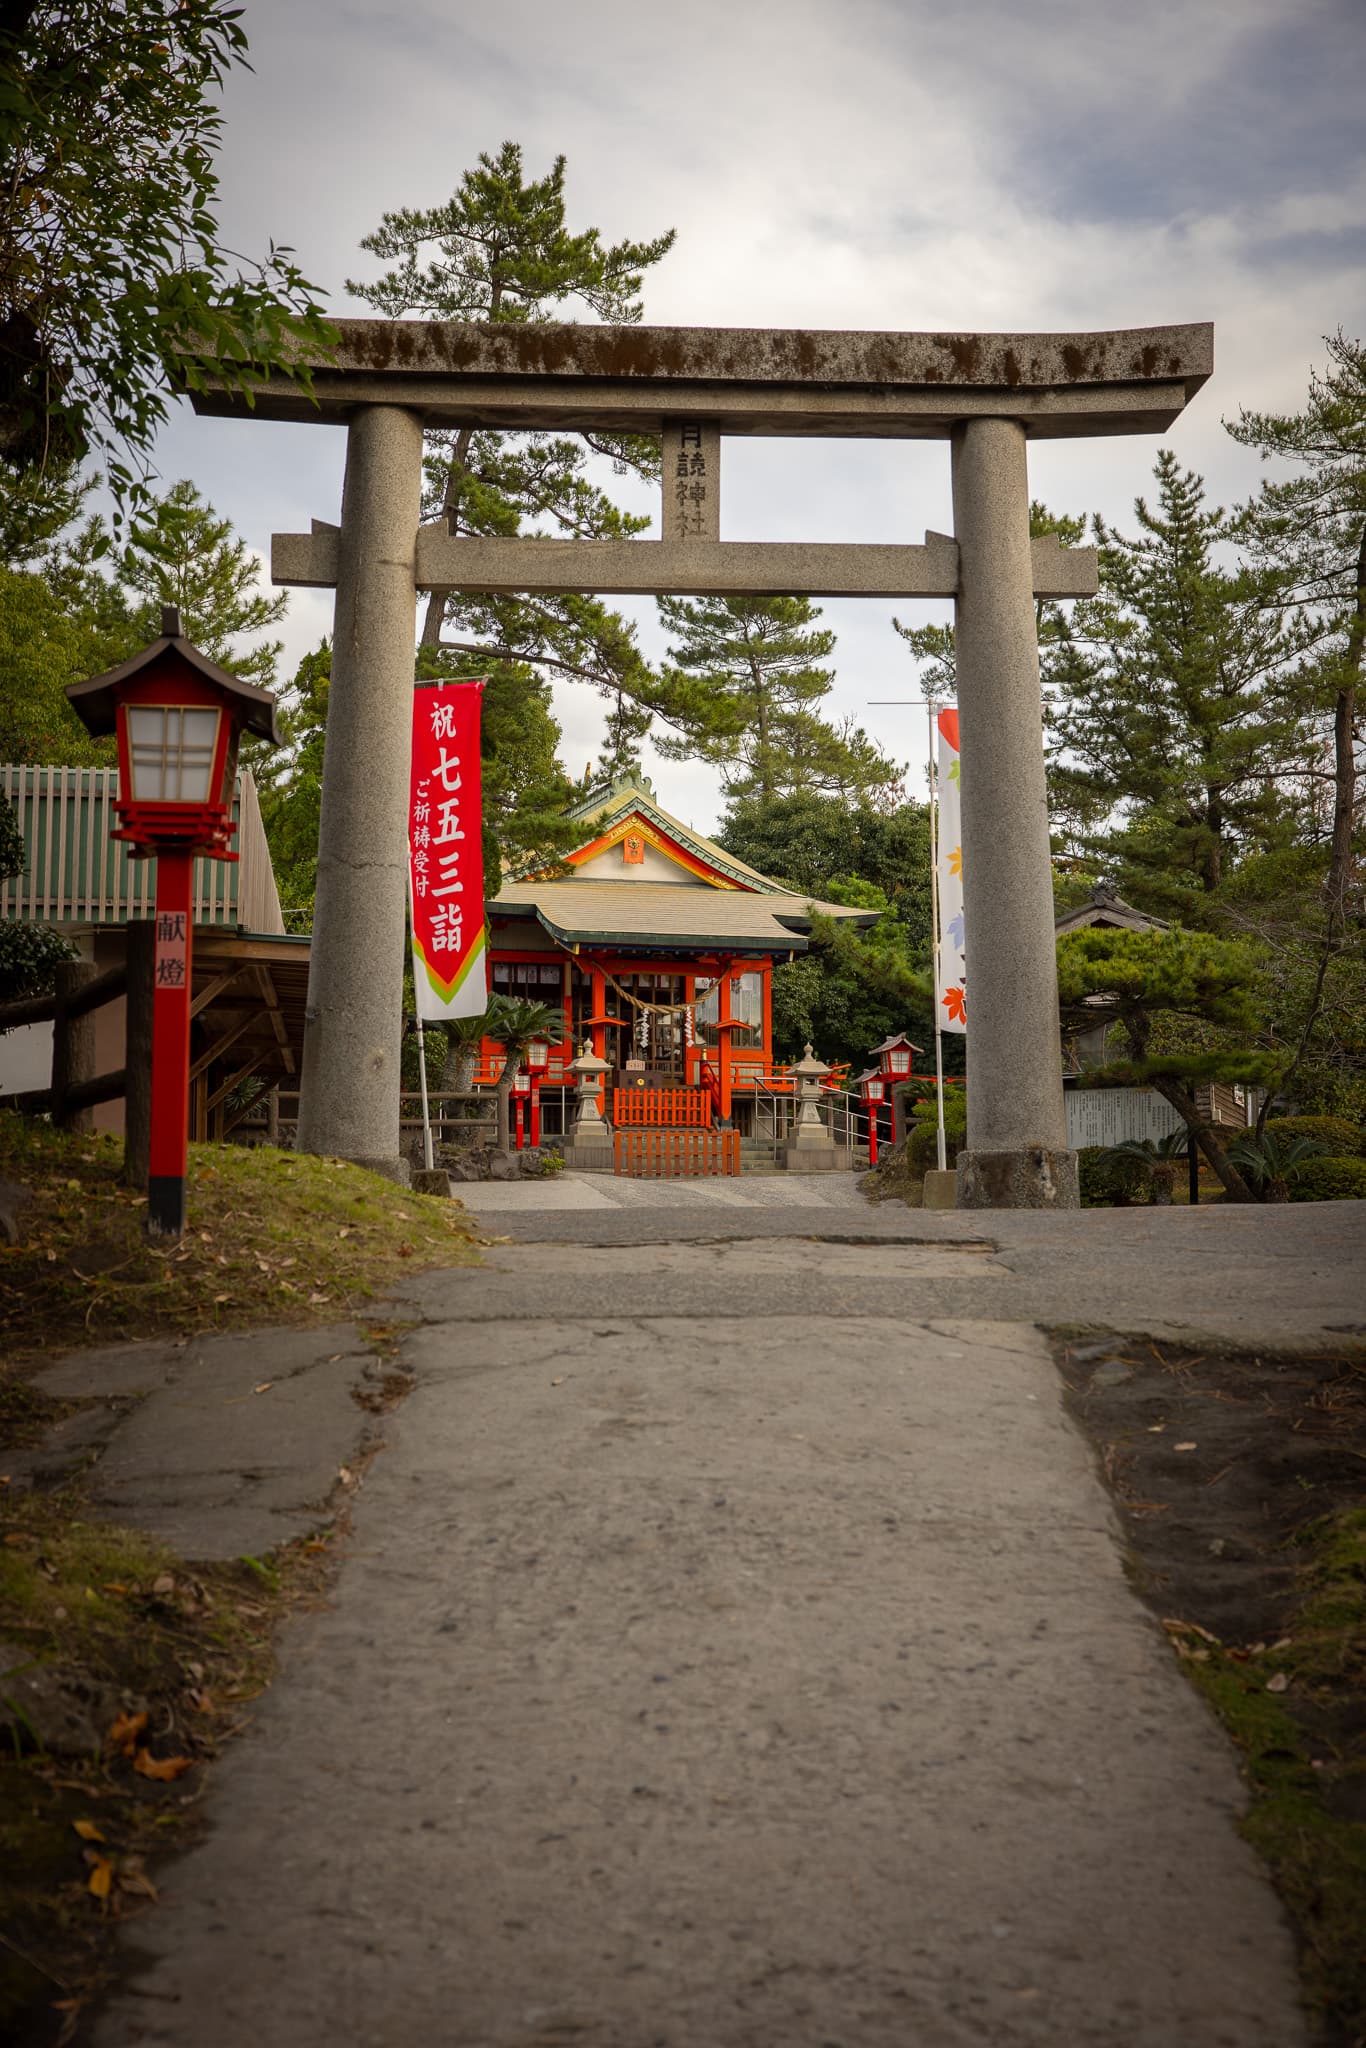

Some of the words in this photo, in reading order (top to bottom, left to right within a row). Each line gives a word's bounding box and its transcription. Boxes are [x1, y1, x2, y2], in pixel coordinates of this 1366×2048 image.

[674, 423, 708, 538] 月読神社
[413, 779, 431, 898] ご祈祷受付
[157, 914, 186, 986] 献燈
